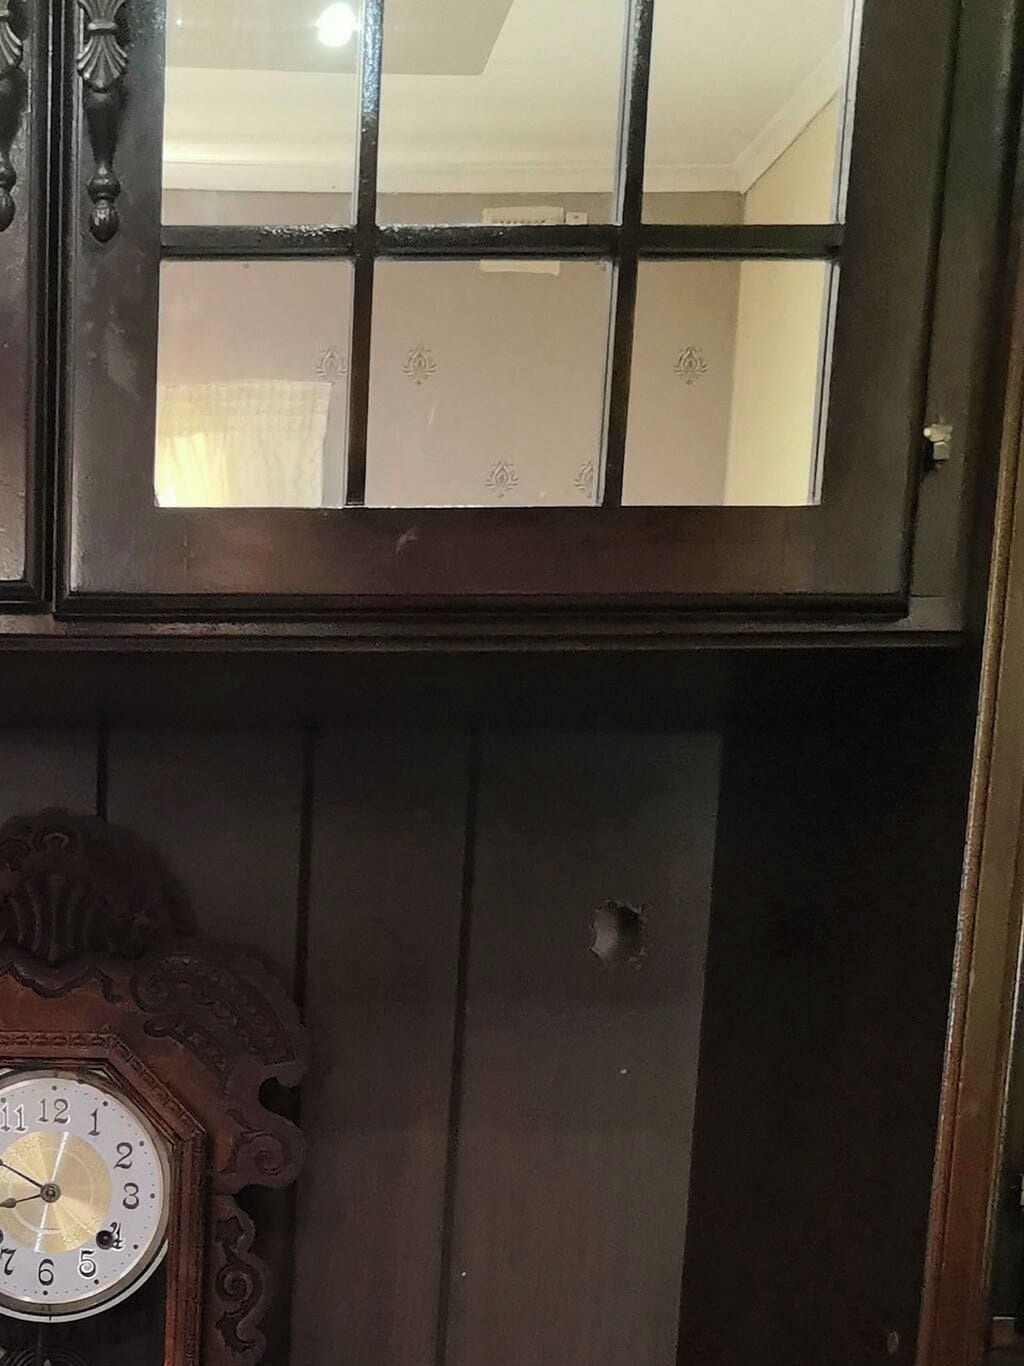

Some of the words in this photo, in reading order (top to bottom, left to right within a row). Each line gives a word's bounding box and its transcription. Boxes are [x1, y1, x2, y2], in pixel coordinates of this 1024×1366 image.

[0, 1103, 27, 1132] 11
[39, 1098, 70, 1125] 12
[87, 1108, 102, 1137] 1
[114, 1142, 134, 1170] 2
[122, 1182, 140, 1210] 3
[0, 1247, 18, 1276] 7
[38, 1258, 55, 1287] 6
[79, 1250, 97, 1278] 5
